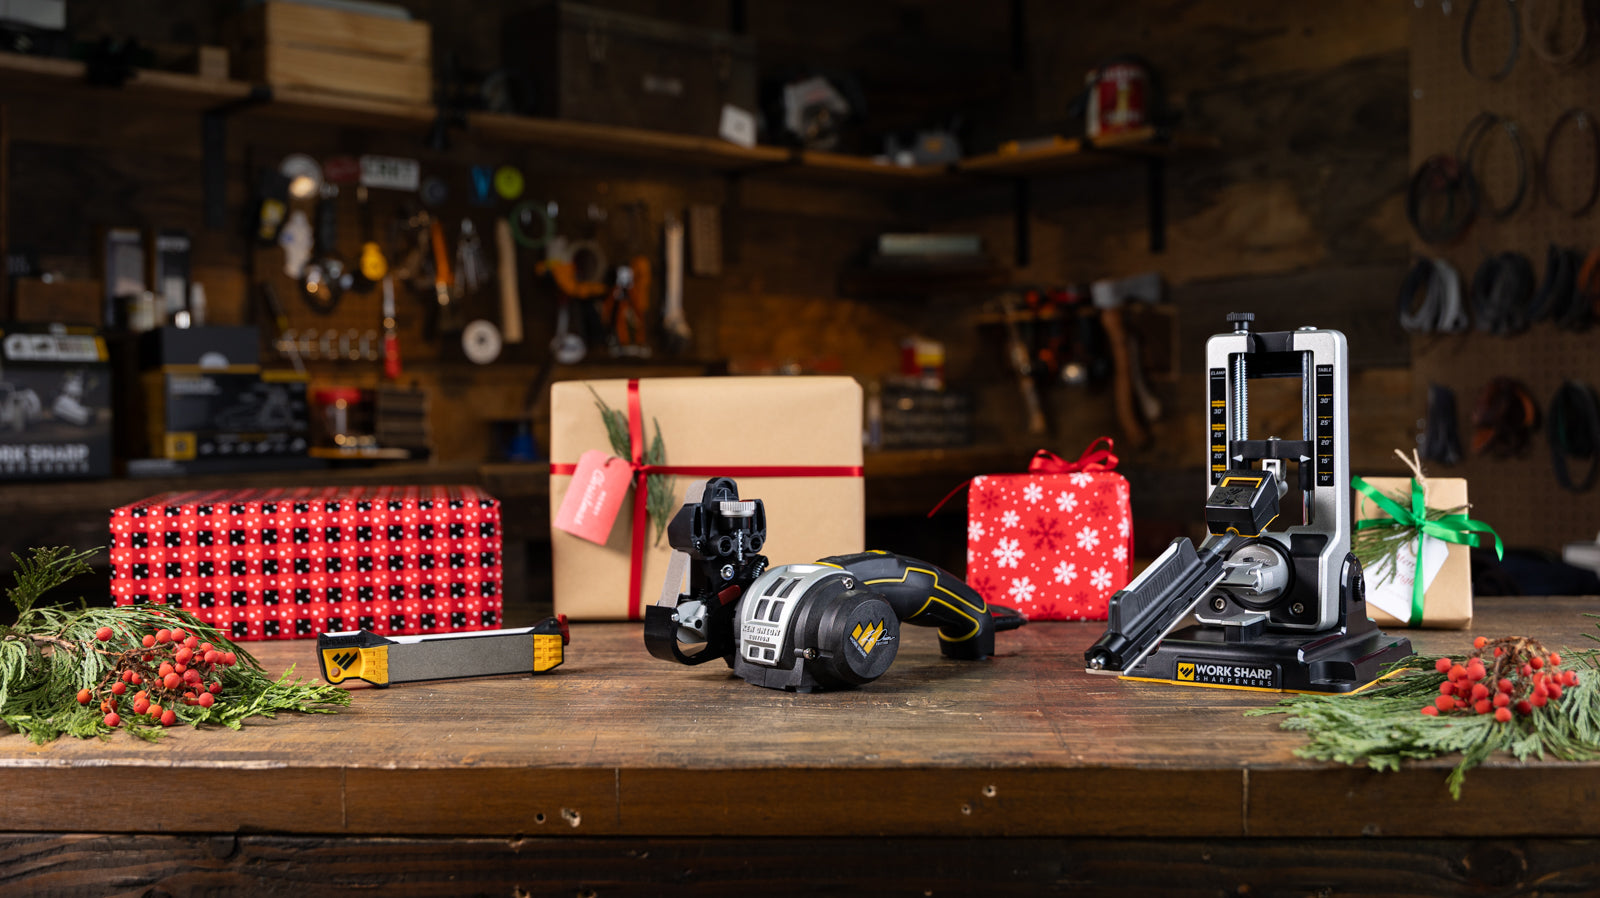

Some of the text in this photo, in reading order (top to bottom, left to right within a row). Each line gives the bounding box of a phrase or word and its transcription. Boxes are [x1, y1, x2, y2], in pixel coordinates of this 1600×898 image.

[1196, 664, 1272, 679] WORK SHARP
[1196, 675, 1272, 687] SHARPENERS
